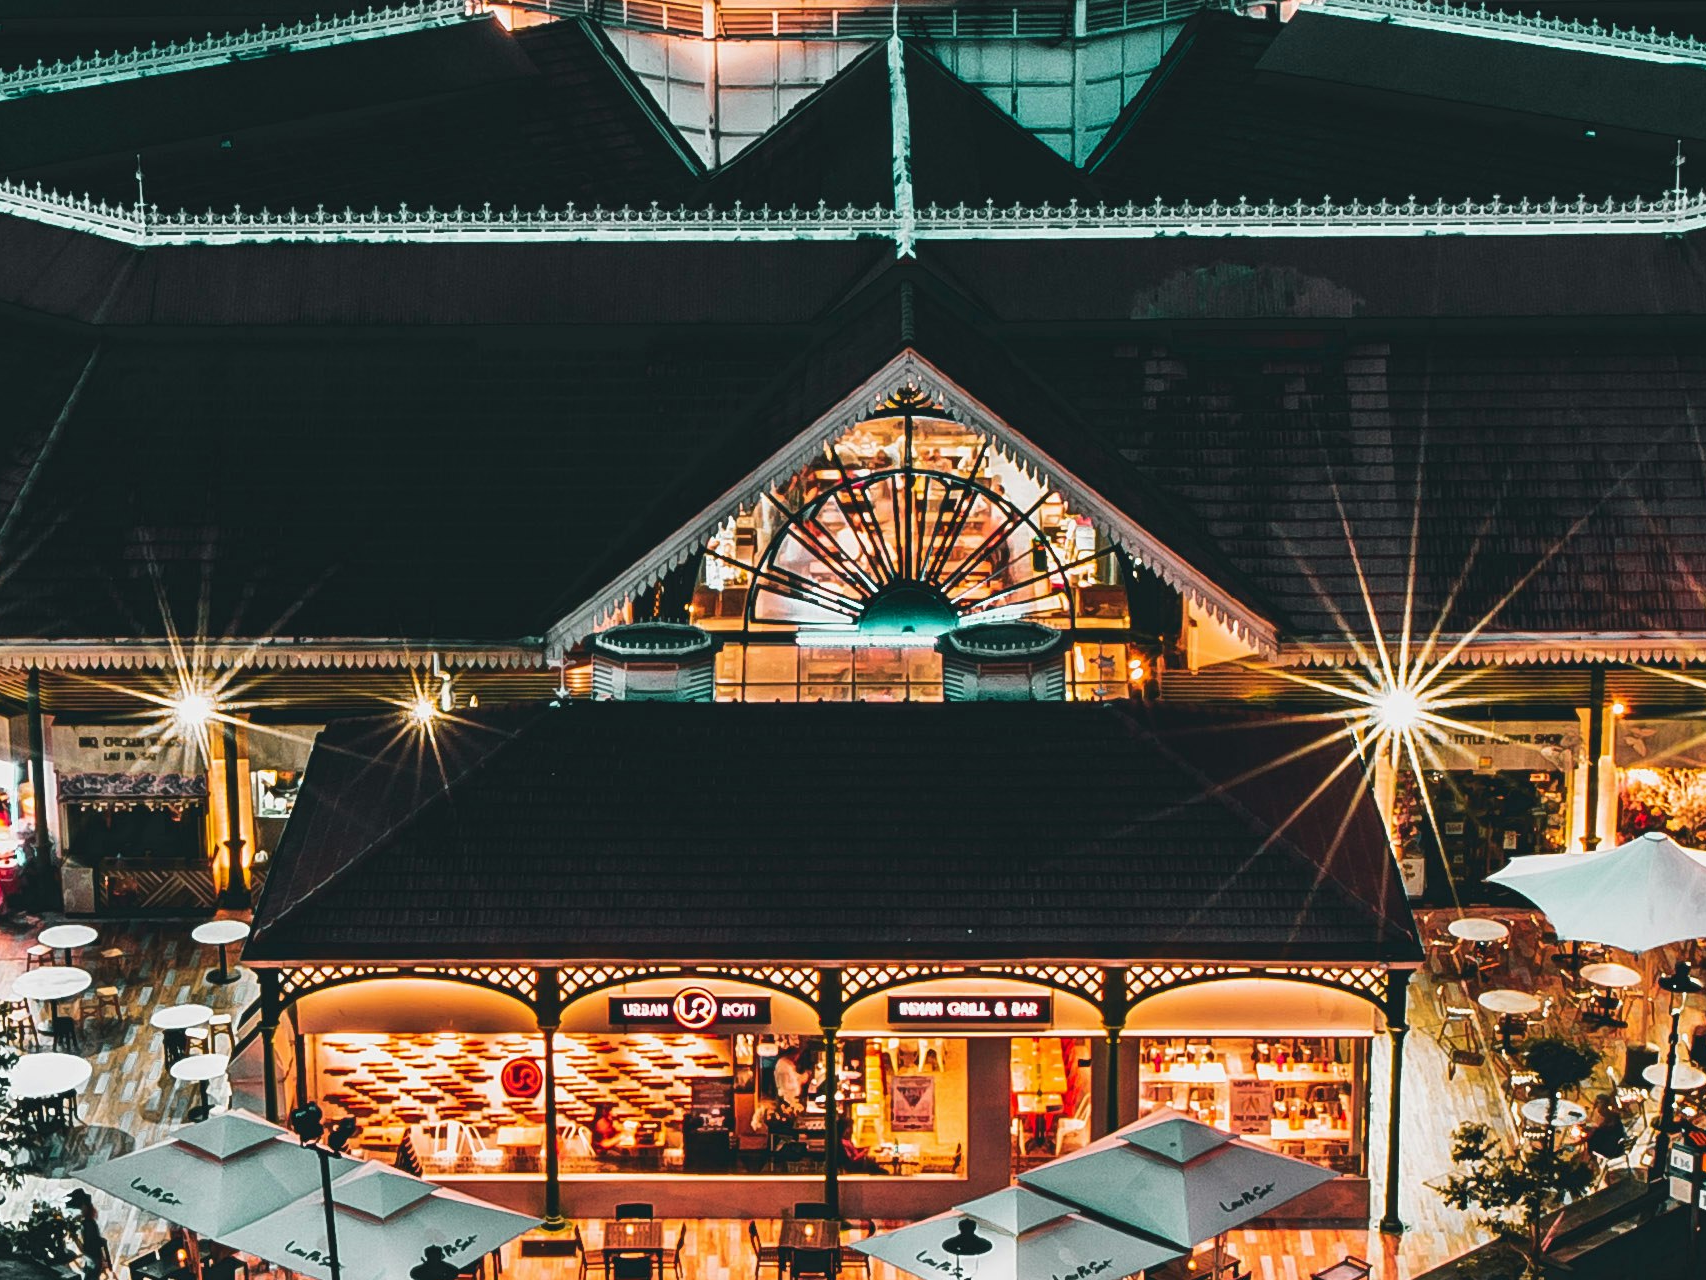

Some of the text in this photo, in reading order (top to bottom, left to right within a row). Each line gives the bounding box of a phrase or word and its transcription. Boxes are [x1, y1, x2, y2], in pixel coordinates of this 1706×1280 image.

[623, 1003, 669, 1017] URBAN
[722, 1003, 755, 1018] ROTI
[899, 1001, 1038, 1017] INDIAN GRILL & BAR
